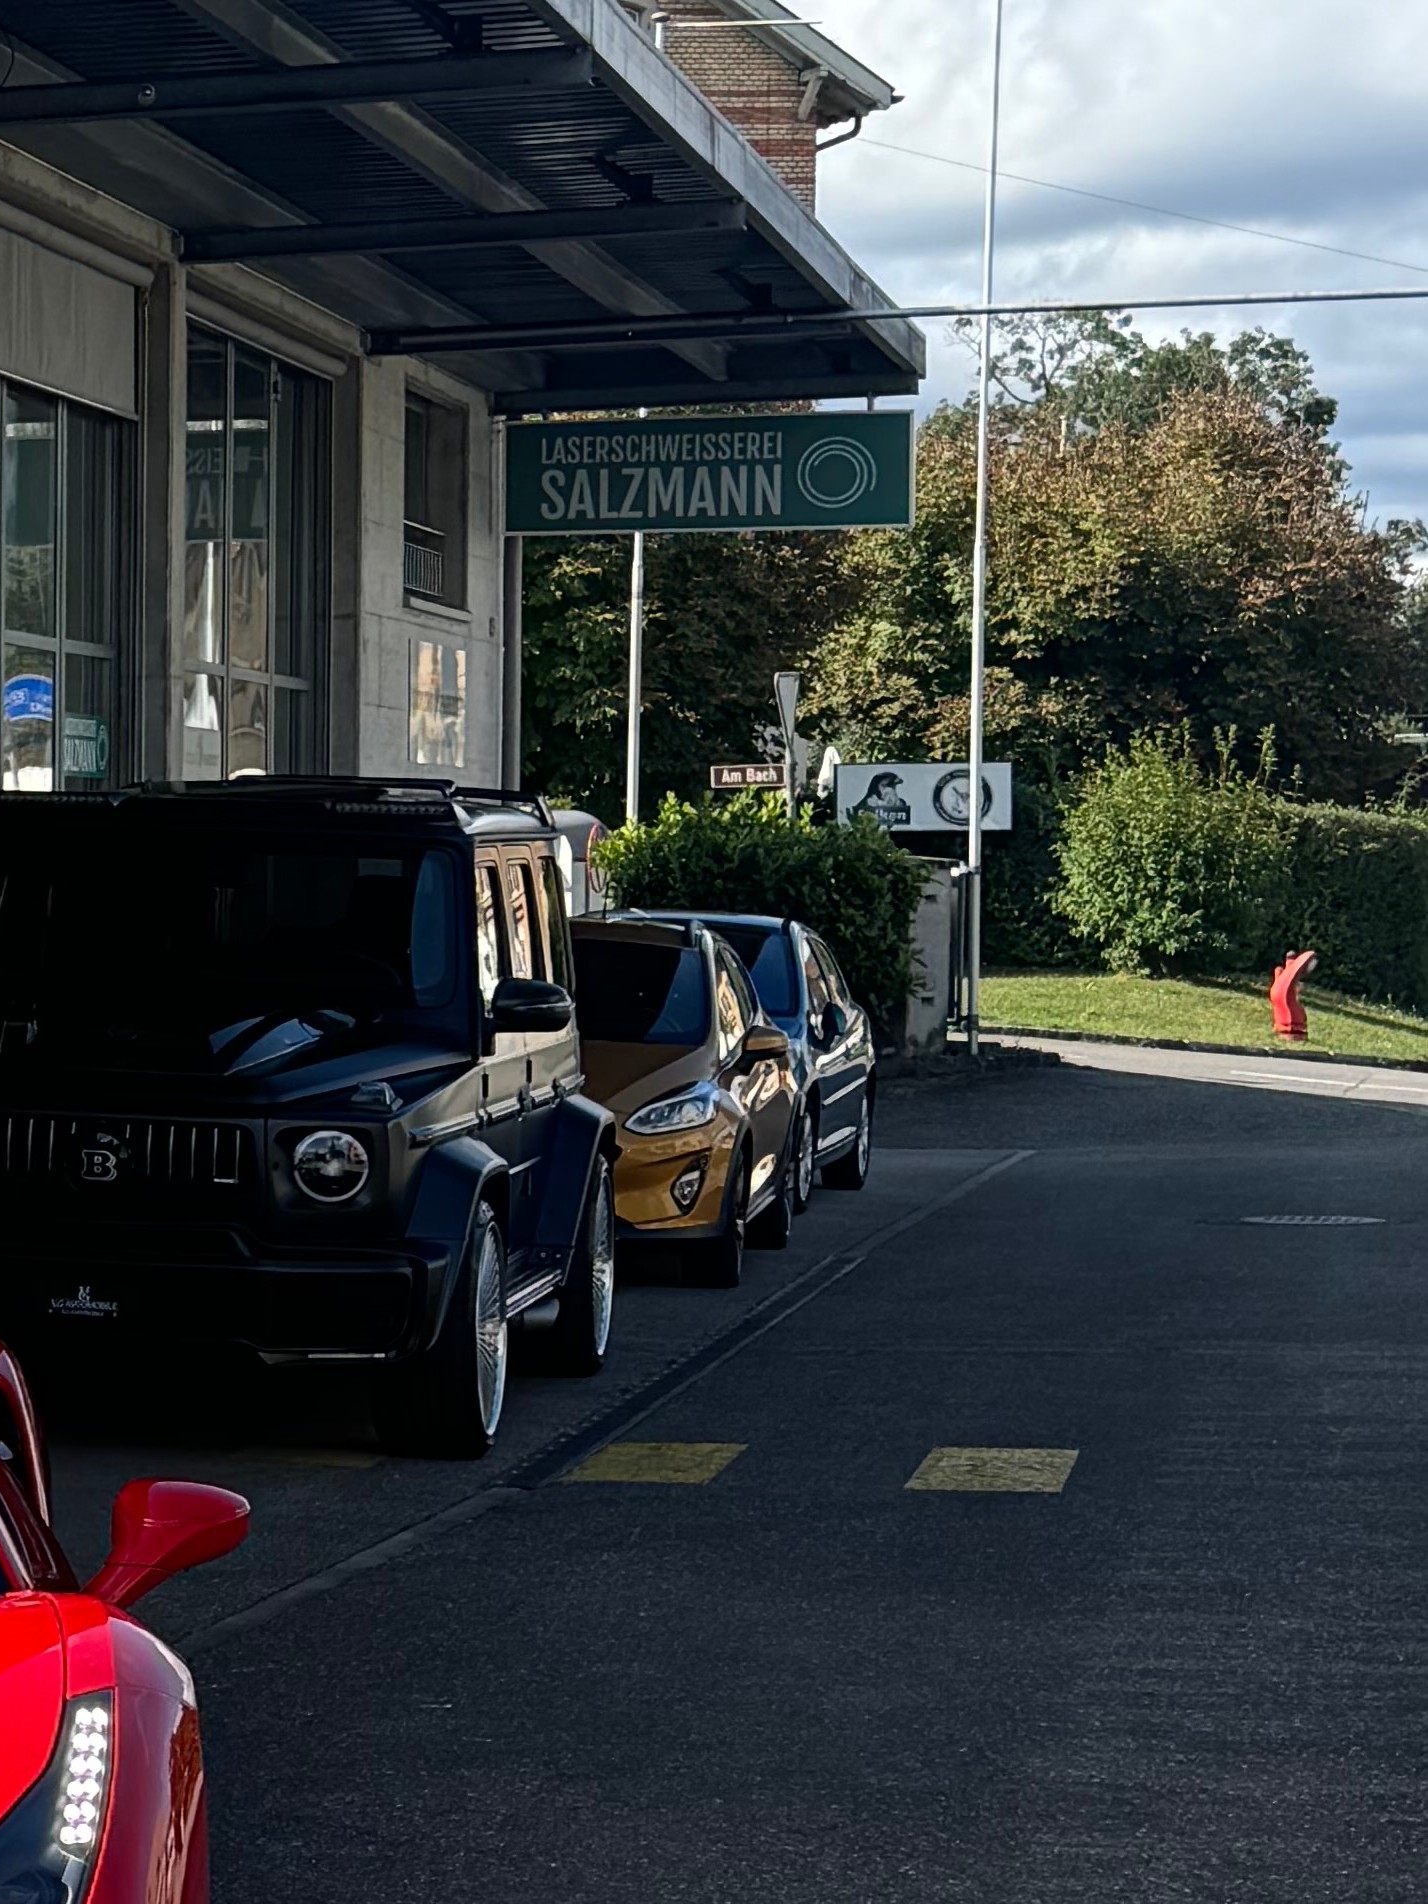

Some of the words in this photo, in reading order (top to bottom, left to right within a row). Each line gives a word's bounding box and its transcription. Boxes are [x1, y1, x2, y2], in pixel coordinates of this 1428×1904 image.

[541, 431, 782, 464] LASERSCHWEISSEREI
[540, 464, 782, 520] SALZMANN
[721, 768, 742, 783] Am
[746, 767, 777, 782] Bach
[81, 1149, 117, 1181] B
